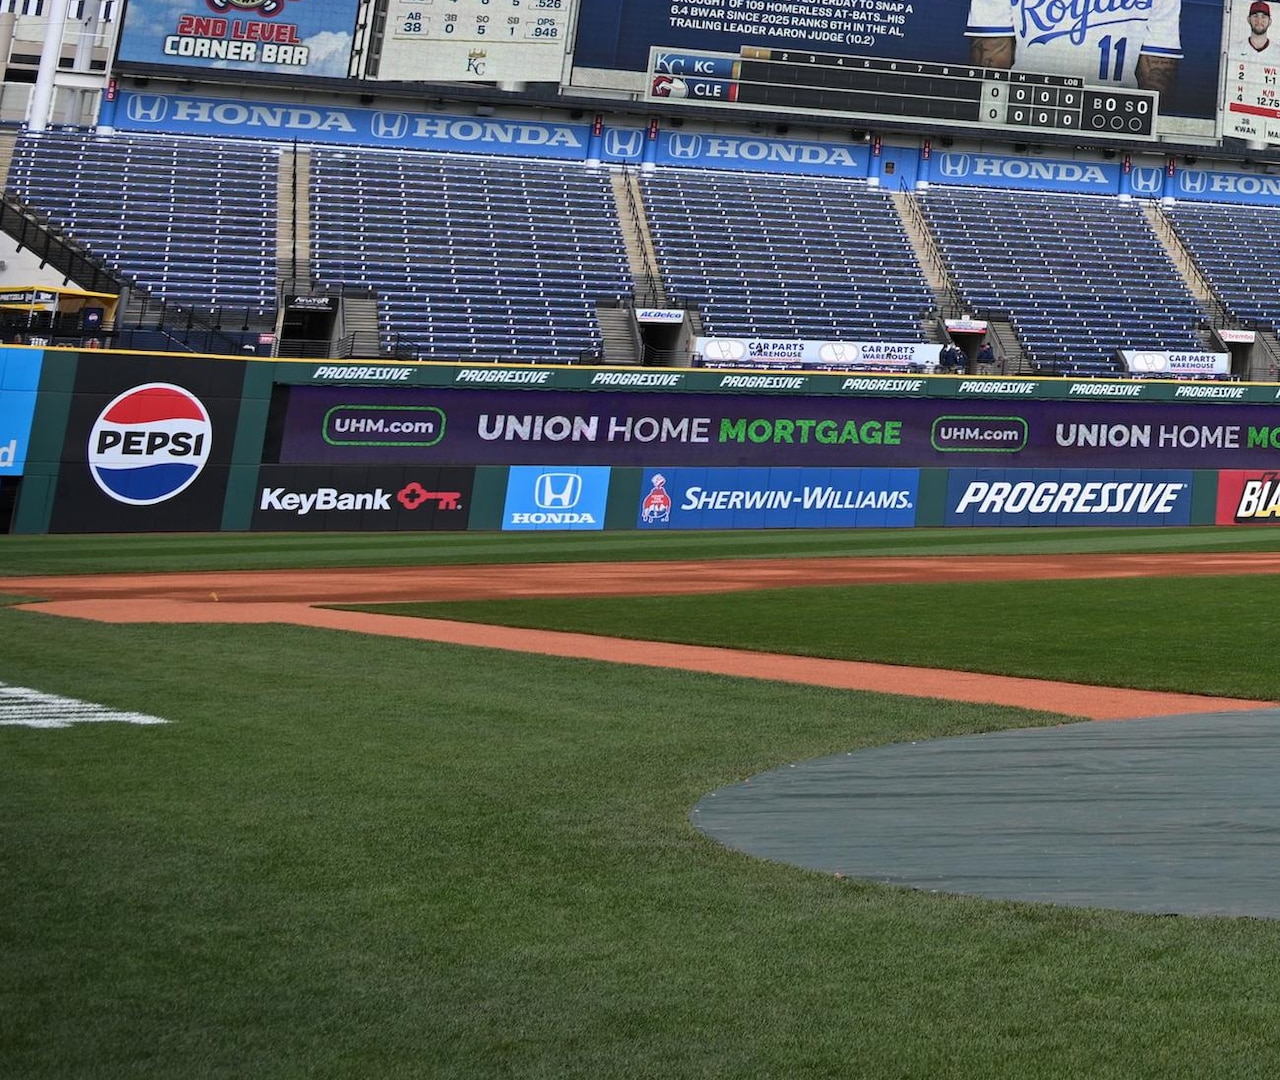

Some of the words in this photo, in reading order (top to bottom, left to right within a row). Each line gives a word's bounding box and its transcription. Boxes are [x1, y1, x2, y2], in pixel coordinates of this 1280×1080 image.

[178, 15, 228, 37] 2ND
[233, 21, 300, 44] LEVEL
[164, 35, 256, 61] CORNER
[262, 45, 309, 65] BAR
[1098, 35, 1127, 81] 11
[694, 84, 722, 97] CLE
[172, 100, 357, 132] HONDA
[414, 117, 583, 149] HONDA
[706, 137, 857, 167] HONDA
[974, 156, 1109, 184] HONDA
[1228, 332, 1254, 340] brembo
[313, 366, 414, 382] PROGRESSIVE
[456, 368, 551, 385] PROGRESSIVE
[591, 373, 683, 386] PROGRESSIVE
[720, 376, 807, 389] PROGRESSIVE
[841, 379, 924, 392] PROGRESSIVE
[958, 382, 1037, 395] PROGRESSIVE
[1069, 384, 1143, 398] PROGRESSIVE
[1175, 386, 1246, 399] PROGRESSIVE
[335, 417, 434, 436] UHM.com
[477, 415, 598, 442] UNION
[607, 417, 711, 443] HOME
[719, 418, 903, 445] MORTGAGE
[940, 426, 1019, 441] UHM.com
[96, 430, 204, 457] PEPSI
[1055, 424, 1151, 448] UNION
[1159, 424, 1240, 449] HOME
[260, 487, 391, 516] KeyBank
[955, 481, 1184, 514] PROGRESSIVE
[511, 513, 595, 525] HONDA
